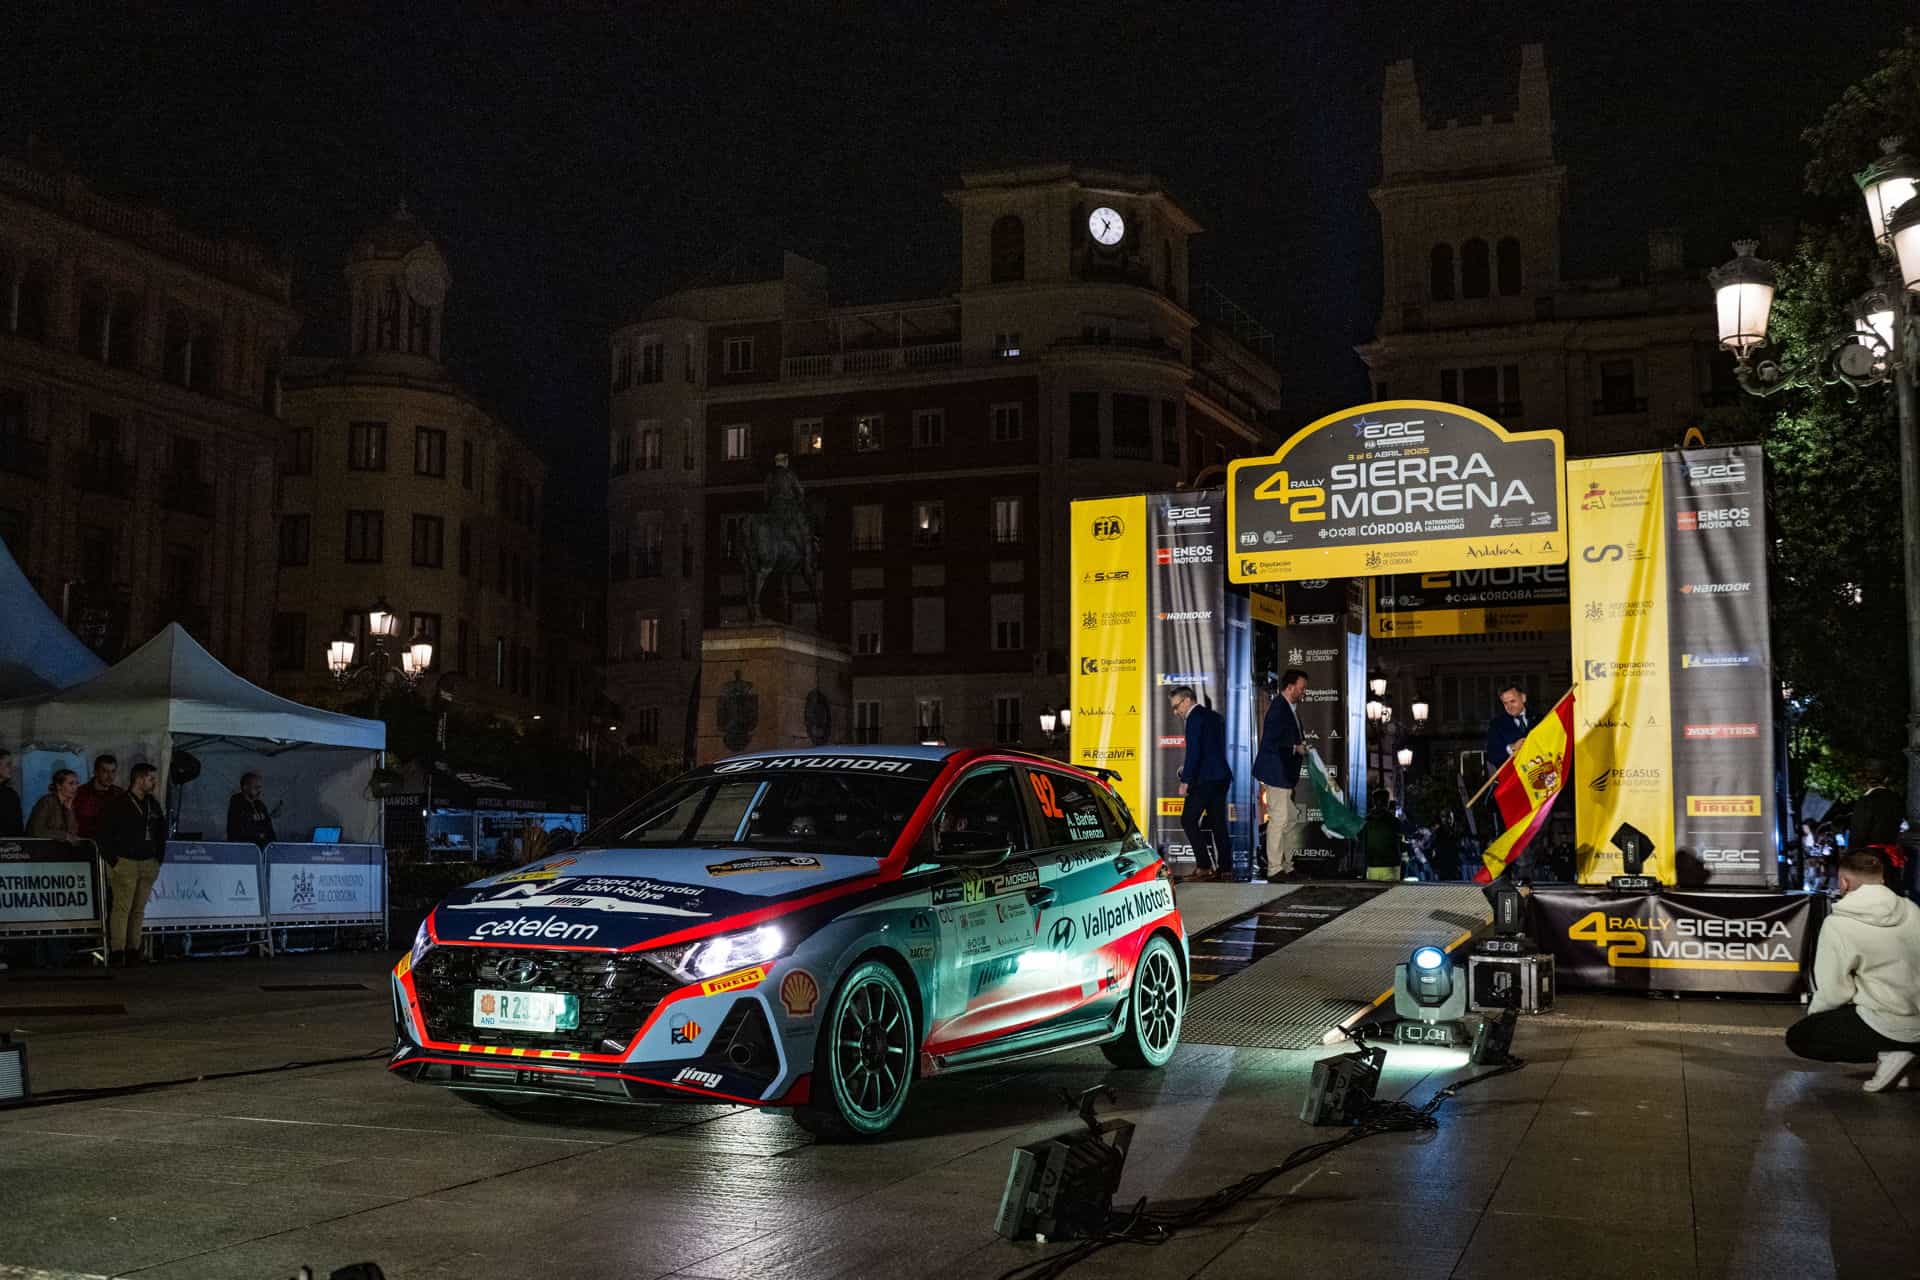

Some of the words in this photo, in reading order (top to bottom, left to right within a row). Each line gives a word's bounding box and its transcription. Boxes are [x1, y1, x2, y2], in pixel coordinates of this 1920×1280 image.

[1363, 420, 1425, 439] ERC
[1374, 450, 1403, 459] ABRIL
[1331, 453, 1495, 491] SIERRA
[1690, 463, 1745, 477] ERC
[1290, 478, 1325, 489] RALLY
[1254, 471, 1326, 522] 42
[1331, 479, 1535, 520] MORENA
[1168, 506, 1211, 520] ERC
[1698, 508, 1750, 521] ENEOS
[1093, 521, 1121, 537] FIA
[1360, 521, 1423, 536] CÓRDOBA
[1698, 520, 1733, 529] MOTOR
[1735, 519, 1751, 527] OIL
[1241, 535, 1257, 545] FIA
[1173, 545, 1213, 557] ENEOS
[1173, 556, 1200, 564] MOTOR
[764, 758, 912, 773] HYUNDAI
[1612, 769, 1660, 778] PEGASUS
[1029, 772, 1064, 819] 92
[1703, 850, 1760, 863] ERC
[1005, 871, 1038, 888] MORENA
[614, 886, 665, 901] Rallye
[631, 879, 705, 896] Hyundai
[1082, 903, 1135, 939] Vallpark
[1135, 886, 1169, 914] Motors
[475, 915, 599, 941] cetelem
[1609, 917, 1672, 931] RALLY
[1676, 918, 1792, 938] SIERRA
[1568, 912, 1646, 967] 42
[1652, 940, 1793, 961] MORENA
[708, 970, 761, 993] PIRELLI
[500, 995, 509, 1019] R
[481, 1017, 495, 1025] AND
[672, 1067, 723, 1088] jimy
